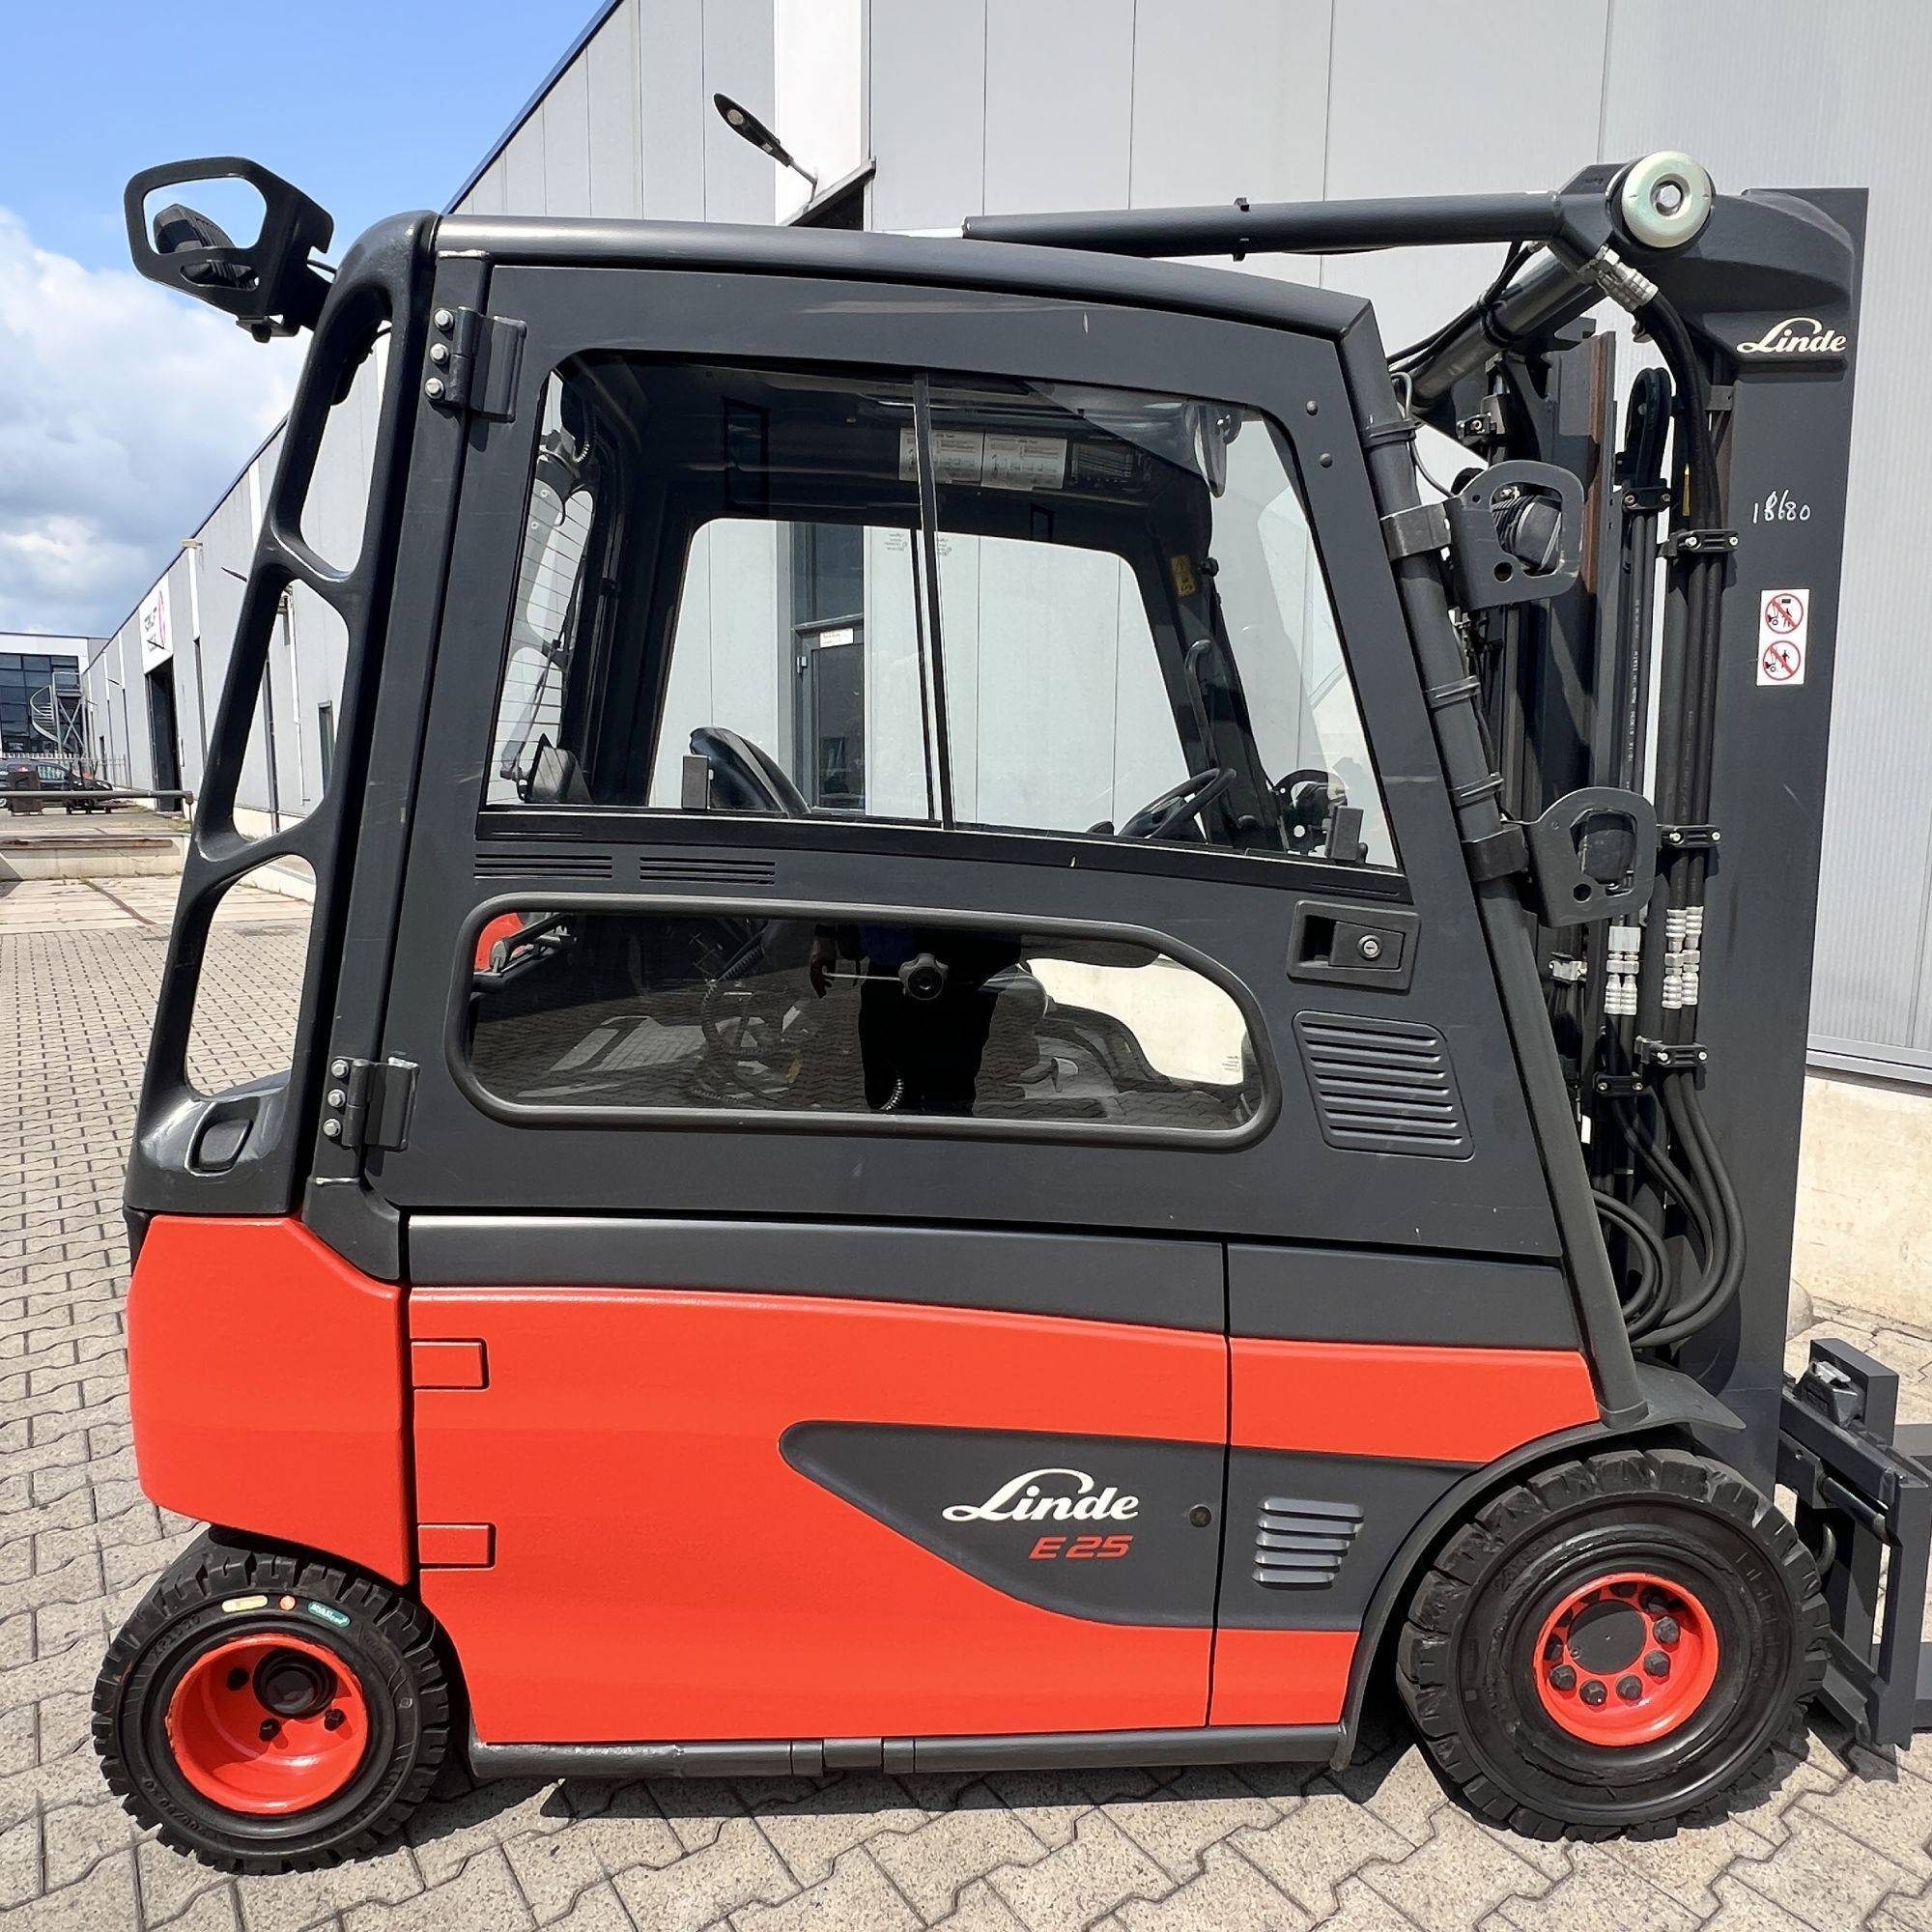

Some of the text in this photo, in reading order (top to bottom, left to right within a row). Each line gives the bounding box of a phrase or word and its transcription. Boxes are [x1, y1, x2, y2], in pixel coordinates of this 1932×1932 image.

[1737, 317, 1847, 354] Linde
[942, 1467, 1139, 1521] Linde
[1029, 1535, 1133, 1560] E 25
